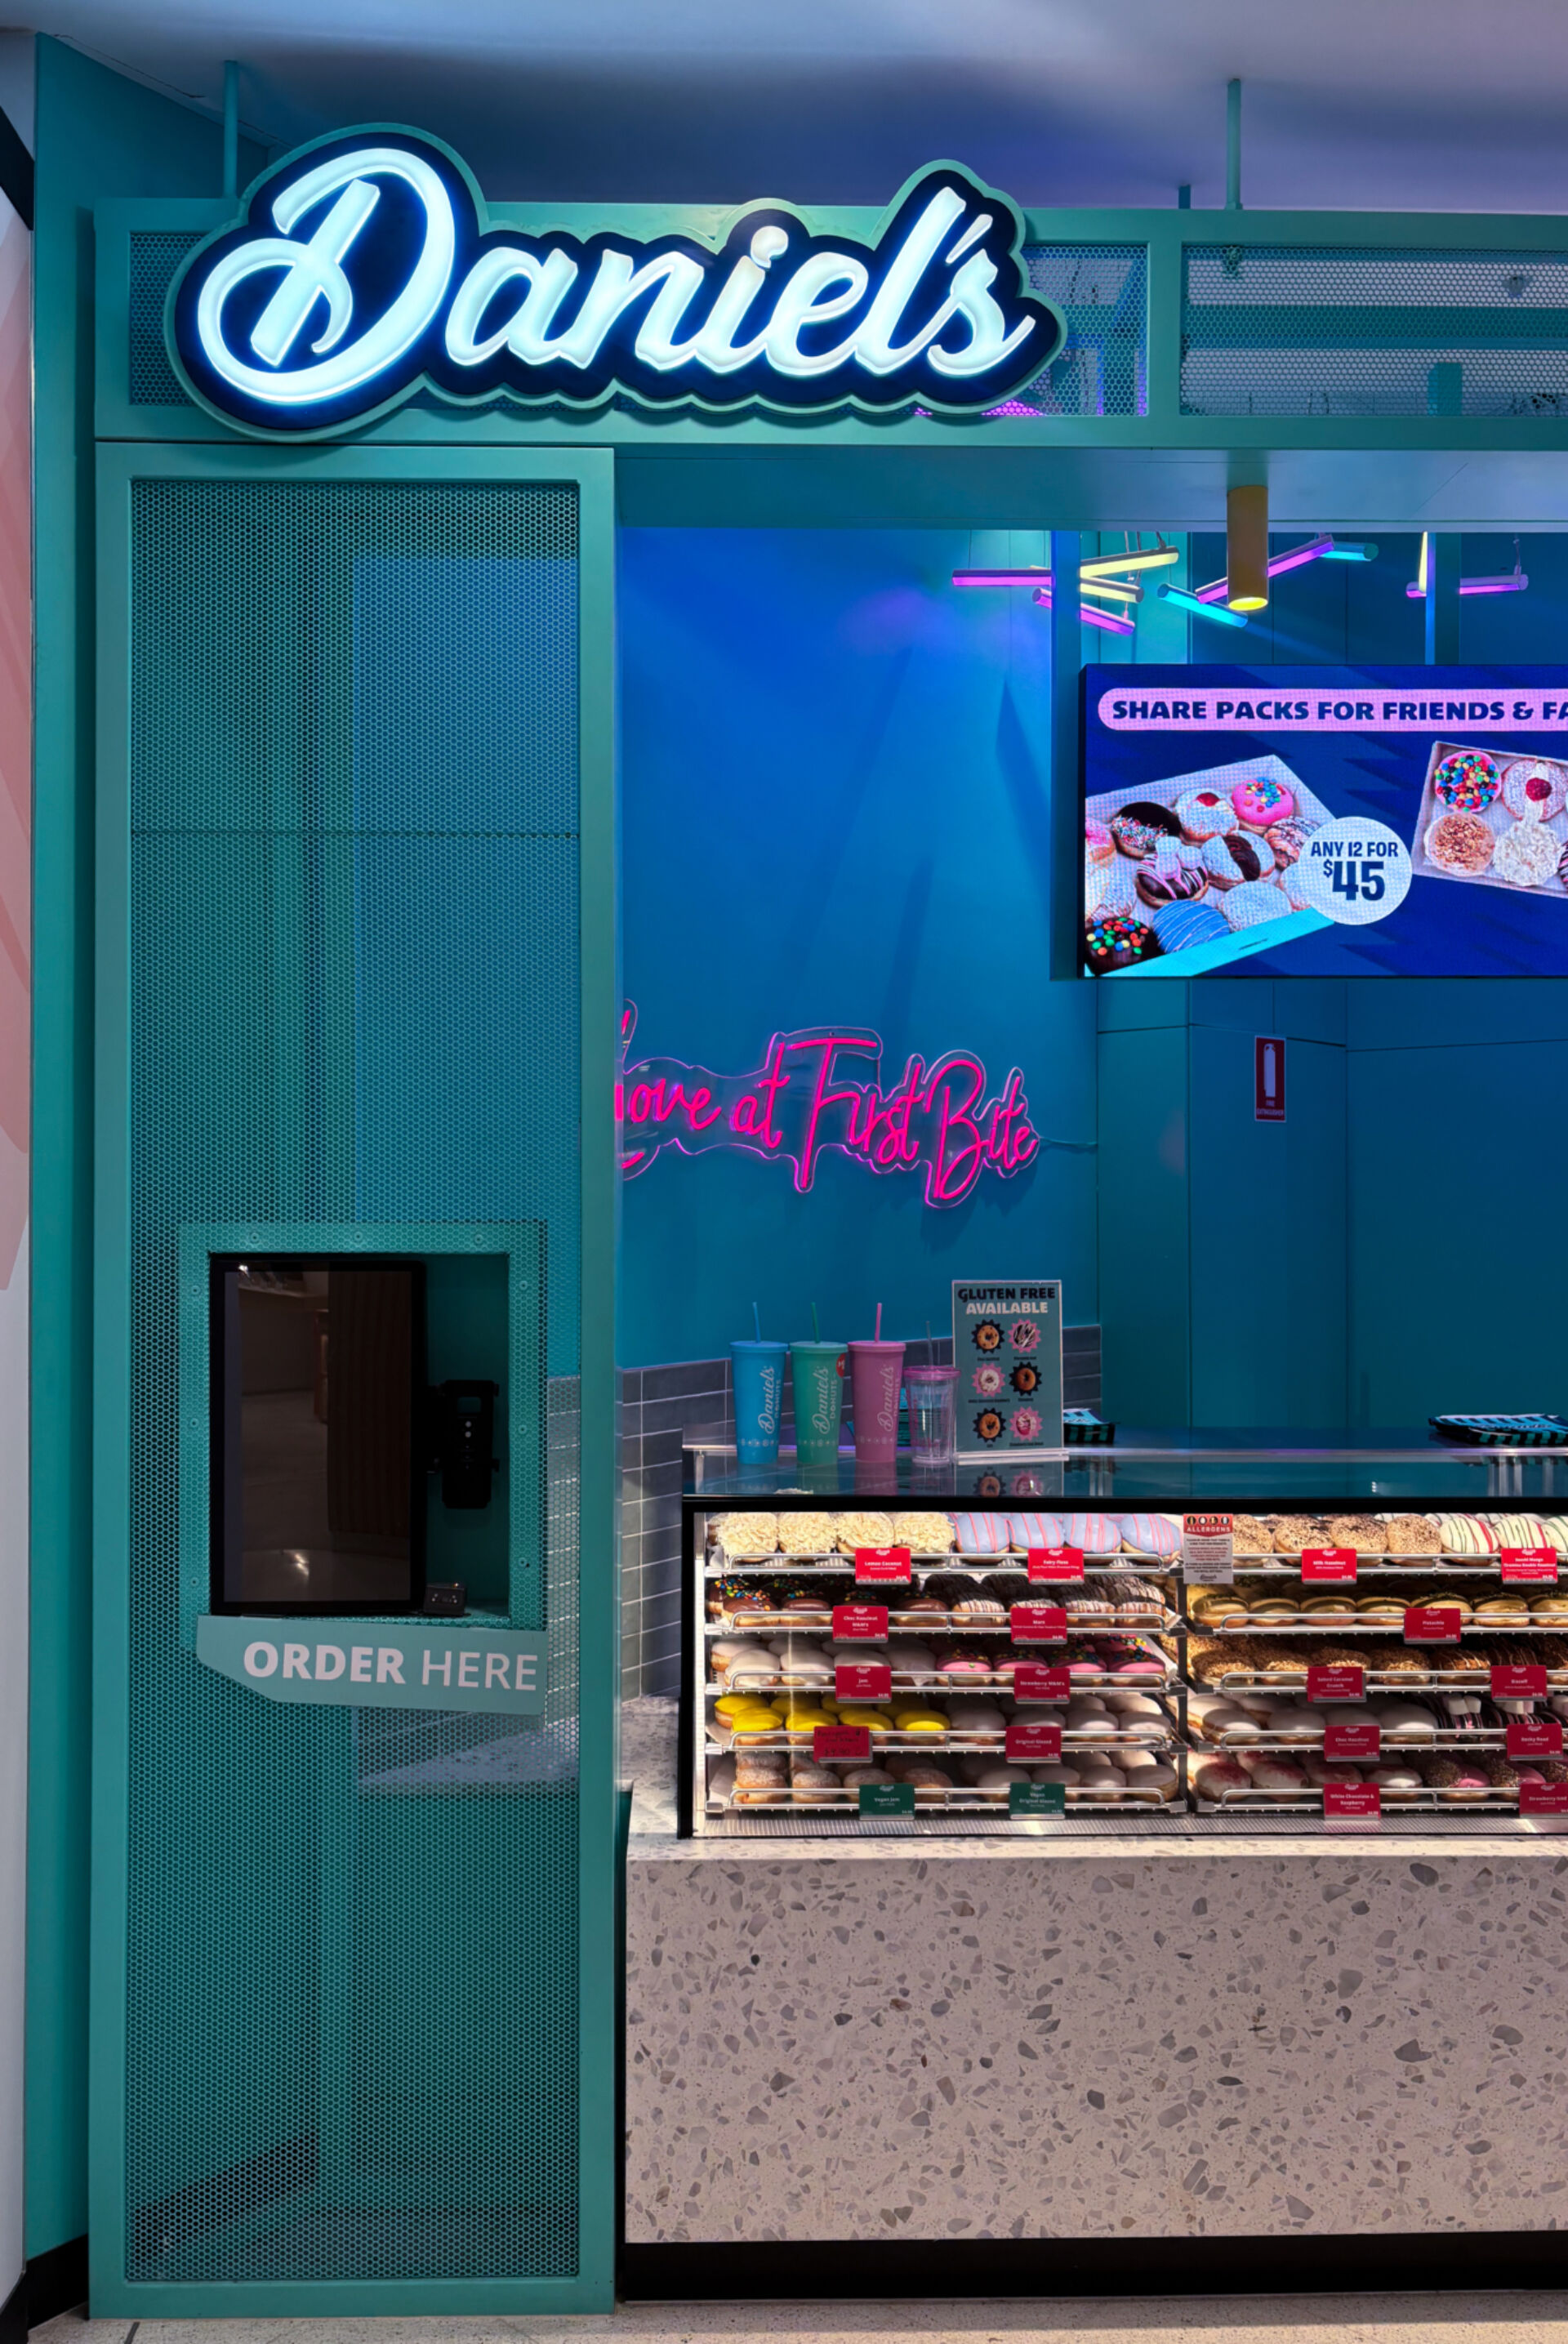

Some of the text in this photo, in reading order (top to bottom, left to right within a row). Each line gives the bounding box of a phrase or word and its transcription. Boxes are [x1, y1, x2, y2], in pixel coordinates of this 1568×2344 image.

[197, 146, 1036, 404] Daniel's
[1112, 700, 1206, 720] SHARE
[1216, 700, 1308, 720] PACKS
[1318, 701, 1374, 720] FOR
[1382, 701, 1504, 720] FRIENDS
[1512, 701, 1534, 720] &
[1311, 840, 1399, 858] ANY 12 FOR
[1323, 859, 1386, 901] $45
[732, 1042, 791, 1149] at
[790, 1037, 924, 1189] First
[924, 1059, 1038, 1200] Bite
[957, 1287, 1055, 1303] GLUTEN FREE
[966, 1302, 1048, 1314] AVAILABLE
[758, 1366, 775, 1435] Daniel's
[812, 1366, 831, 1435] Daniel's
[830, 1379, 838, 1419] DONUTS
[877, 1364, 894, 1432] Daniel's
[243, 1641, 539, 1691] ORDER HERE
